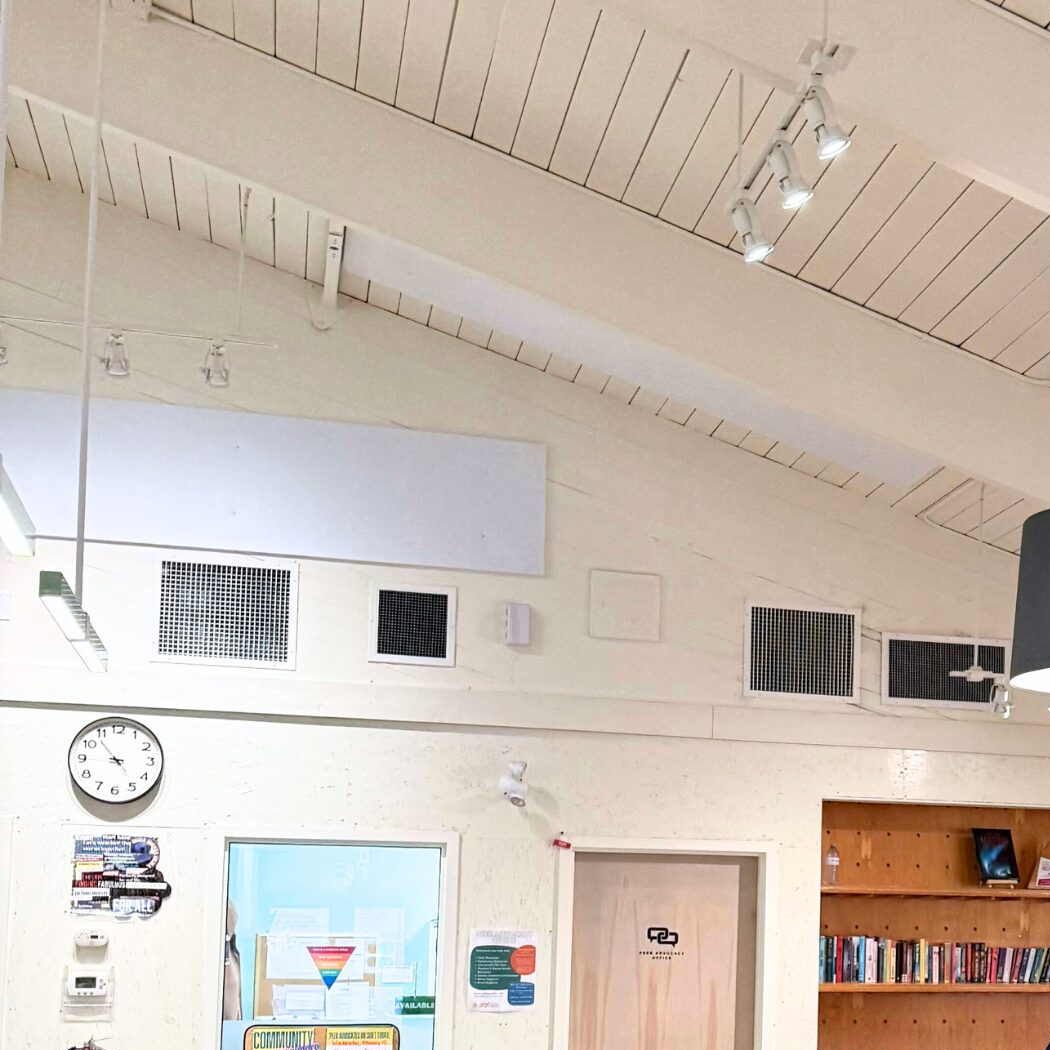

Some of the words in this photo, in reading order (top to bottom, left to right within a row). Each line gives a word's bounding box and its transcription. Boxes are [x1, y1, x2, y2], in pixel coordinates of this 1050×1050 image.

[96, 728, 106, 738] 11
[112, 724, 126, 735] 12
[83, 739, 97, 749] 10
[141, 741, 151, 752] 2
[77, 753, 87, 763] 9
[145, 756, 155, 766] 3
[81, 769, 91, 779] 8
[139, 772, 148, 781] 4
[95, 780, 104, 791] 7
[127, 782, 137, 792] 5
[110, 786, 119, 796] 6
[253, 1030, 313, 1049] COMMUNITY
